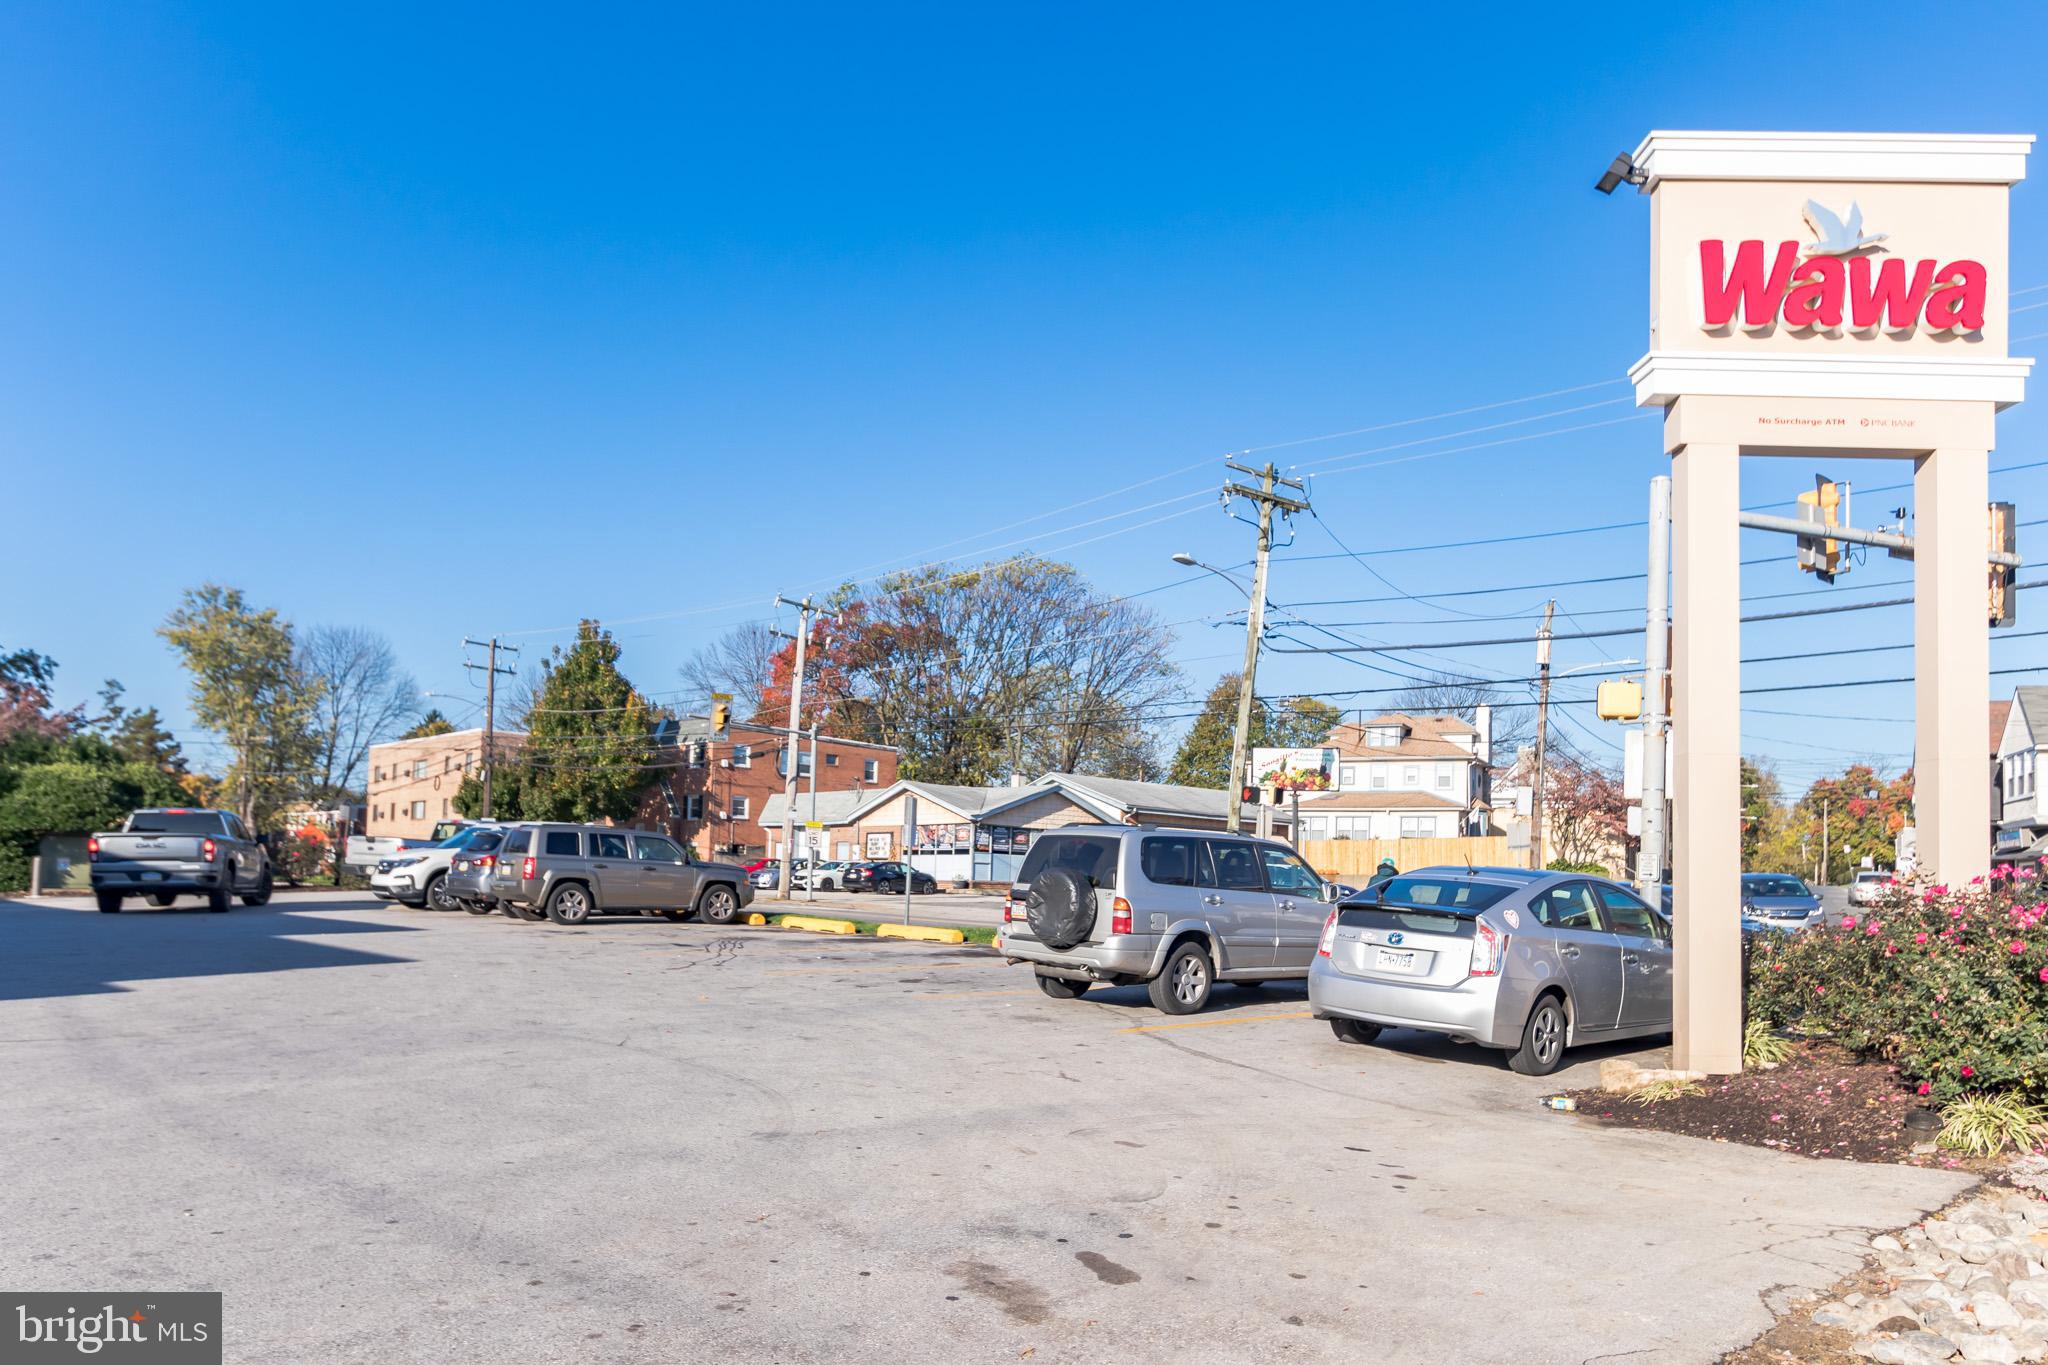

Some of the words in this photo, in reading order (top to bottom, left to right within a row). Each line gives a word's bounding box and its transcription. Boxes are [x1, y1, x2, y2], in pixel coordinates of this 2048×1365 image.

[1700, 239, 1987, 331] Wawa
[1758, 417, 1772, 425] No
[1774, 417, 1823, 427] Surcharge
[1825, 418, 1846, 426] ATM
[808, 836, 818, 845] 15
